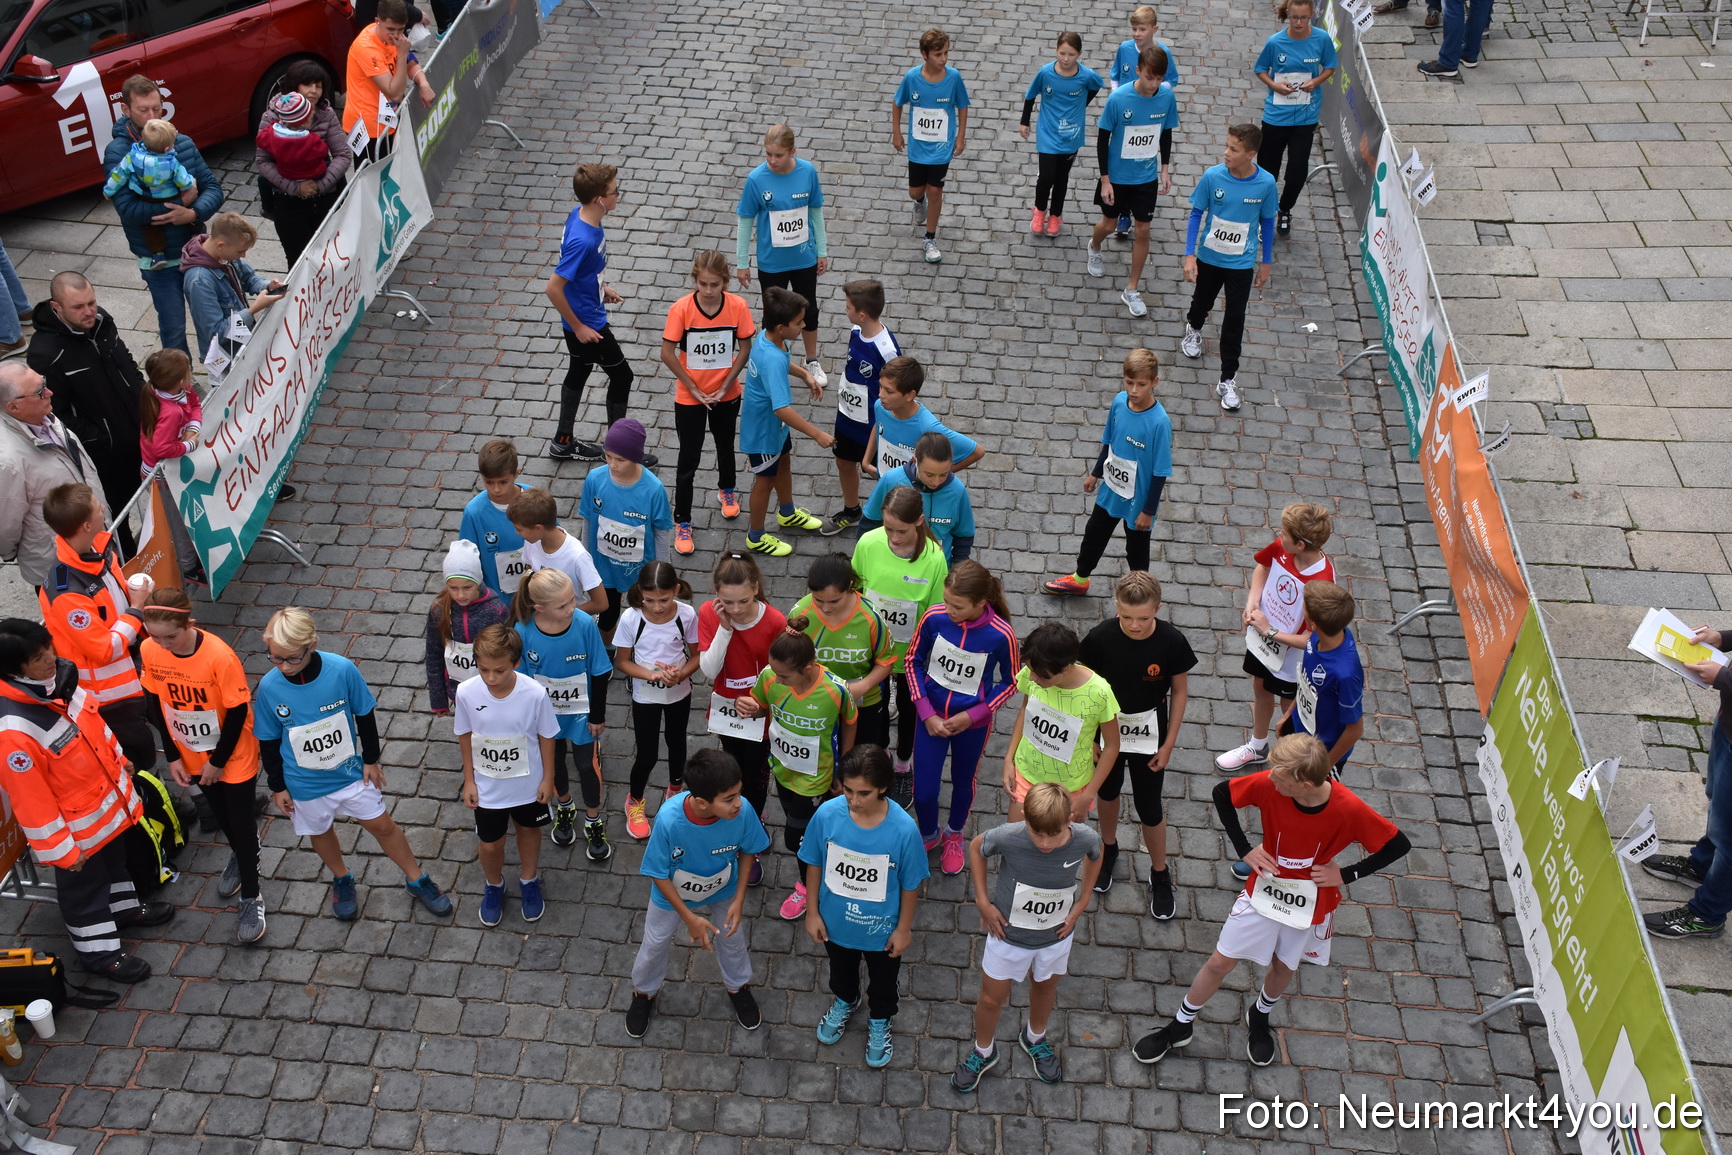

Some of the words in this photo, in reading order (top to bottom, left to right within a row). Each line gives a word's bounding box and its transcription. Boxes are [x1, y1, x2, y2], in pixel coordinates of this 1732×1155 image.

[1358, 12, 1372, 27] swn
[918, 117, 943, 129] 4017
[1128, 135, 1154, 147] 4097
[1417, 182, 1433, 199] swn
[777, 218, 804, 233] 4029
[1213, 228, 1241, 244] 4040
[693, 343, 726, 356] 4013
[841, 391, 863, 408] 4022
[1456, 386, 1477, 404] swn
[1486, 437, 1509, 453] swn
[1106, 462, 1129, 482] 4026
[603, 531, 637, 548] 4009
[815, 647, 869, 664] OCK
[937, 654, 976, 679] 4019
[167, 683, 208, 704] RUN
[1537, 677, 1554, 723] Der
[320, 699, 346, 713] BOCK
[771, 704, 827, 731] BOCK
[173, 720, 211, 736] 4010
[729, 722, 744, 730] Katja
[1031, 715, 1069, 743] 4004
[303, 729, 343, 754] 4030
[775, 737, 810, 759] 4039
[480, 747, 520, 762] 4045
[1515, 665, 1549, 778] Neue
[1563, 843, 1585, 904] wo's
[535, 813, 548, 821] JAKO
[1629, 833, 1657, 856] swn
[835, 862, 878, 882] 4028
[681, 877, 722, 893] 4033
[842, 882, 868, 892] Radwan
[1263, 885, 1307, 908] 4000
[846, 902, 863, 914] 18.
[1022, 900, 1064, 915] 4001
[1271, 903, 1291, 915] Niklas
